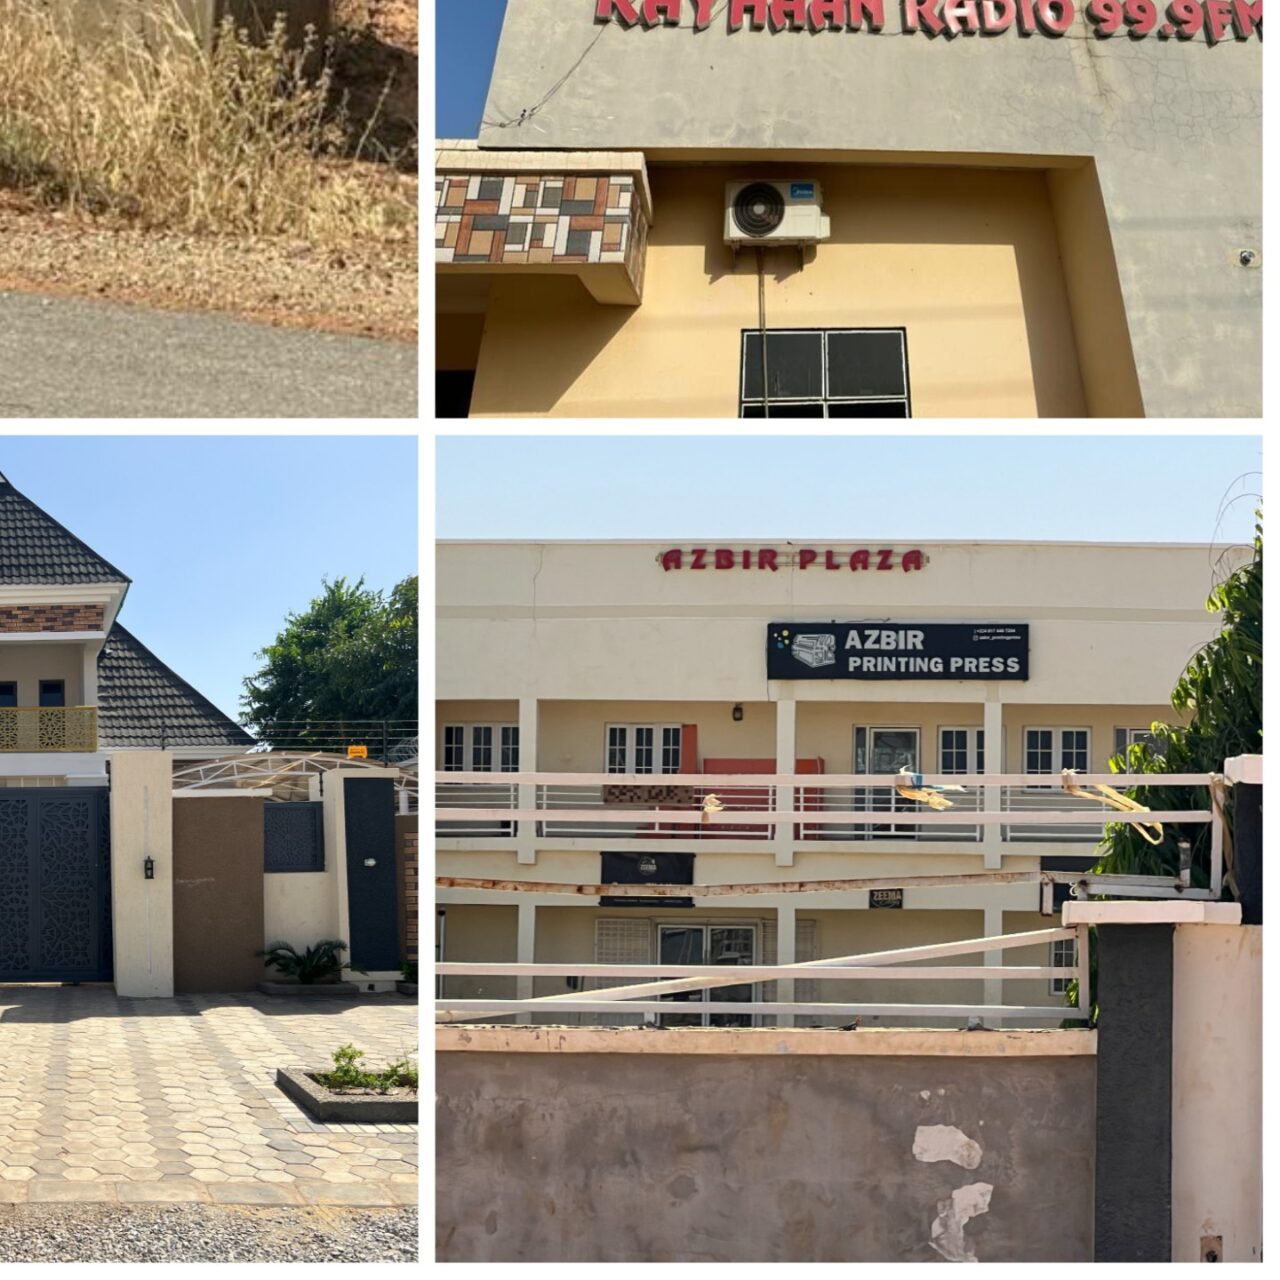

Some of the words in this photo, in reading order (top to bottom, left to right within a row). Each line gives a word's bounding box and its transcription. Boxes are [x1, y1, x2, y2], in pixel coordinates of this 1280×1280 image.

[662, 548, 779, 572] AZBIR
[799, 548, 924, 572] PLAZA
[844, 629, 925, 650] AZBIR
[848, 657, 944, 672] PRINTING
[950, 657, 1020, 673] PRESS
